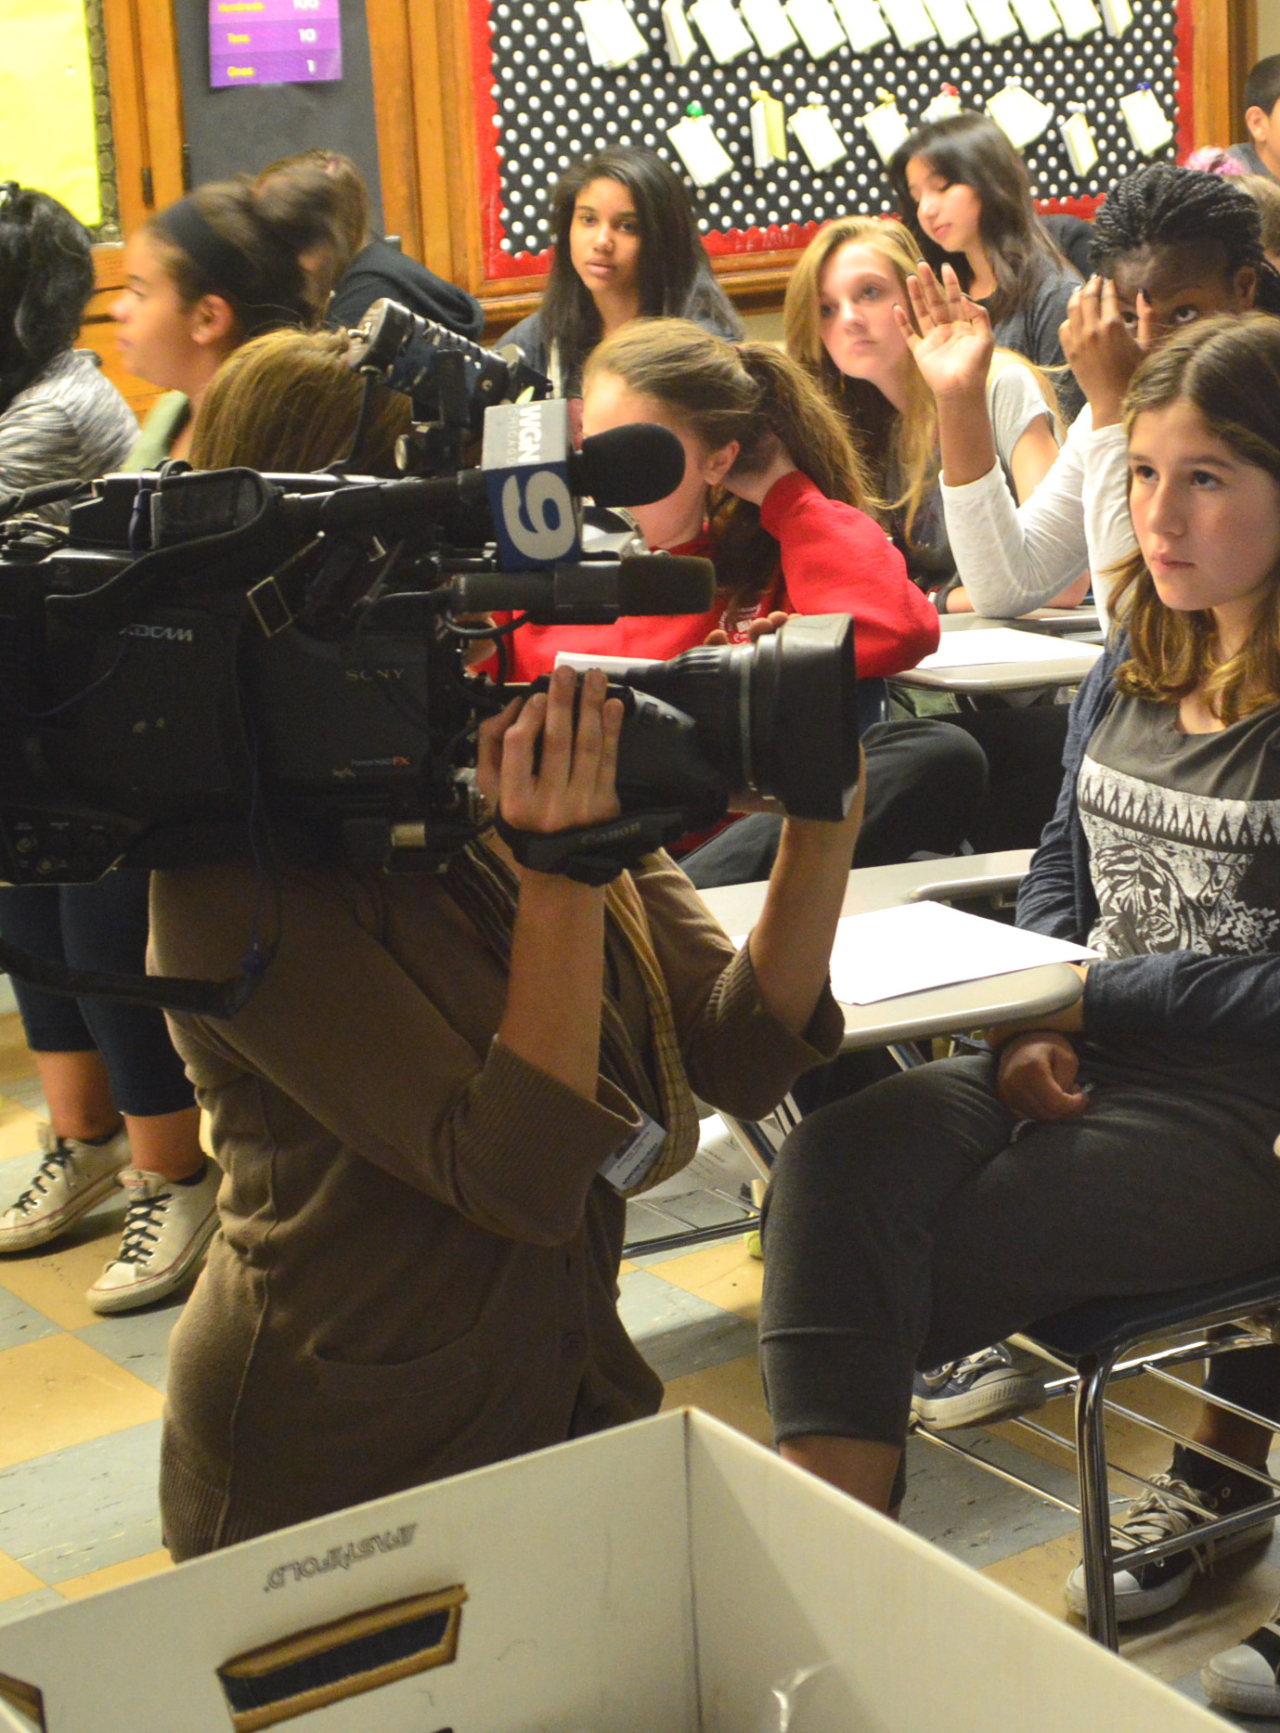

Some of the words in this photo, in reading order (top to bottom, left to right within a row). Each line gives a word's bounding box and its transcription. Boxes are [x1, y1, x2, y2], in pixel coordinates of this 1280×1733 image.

[298, 28, 317, 42] 10
[306, 59, 315, 73] 1
[507, 408, 518, 465] CHICAGO
[518, 403, 542, 463] WGN
[502, 470, 576, 560] 9
